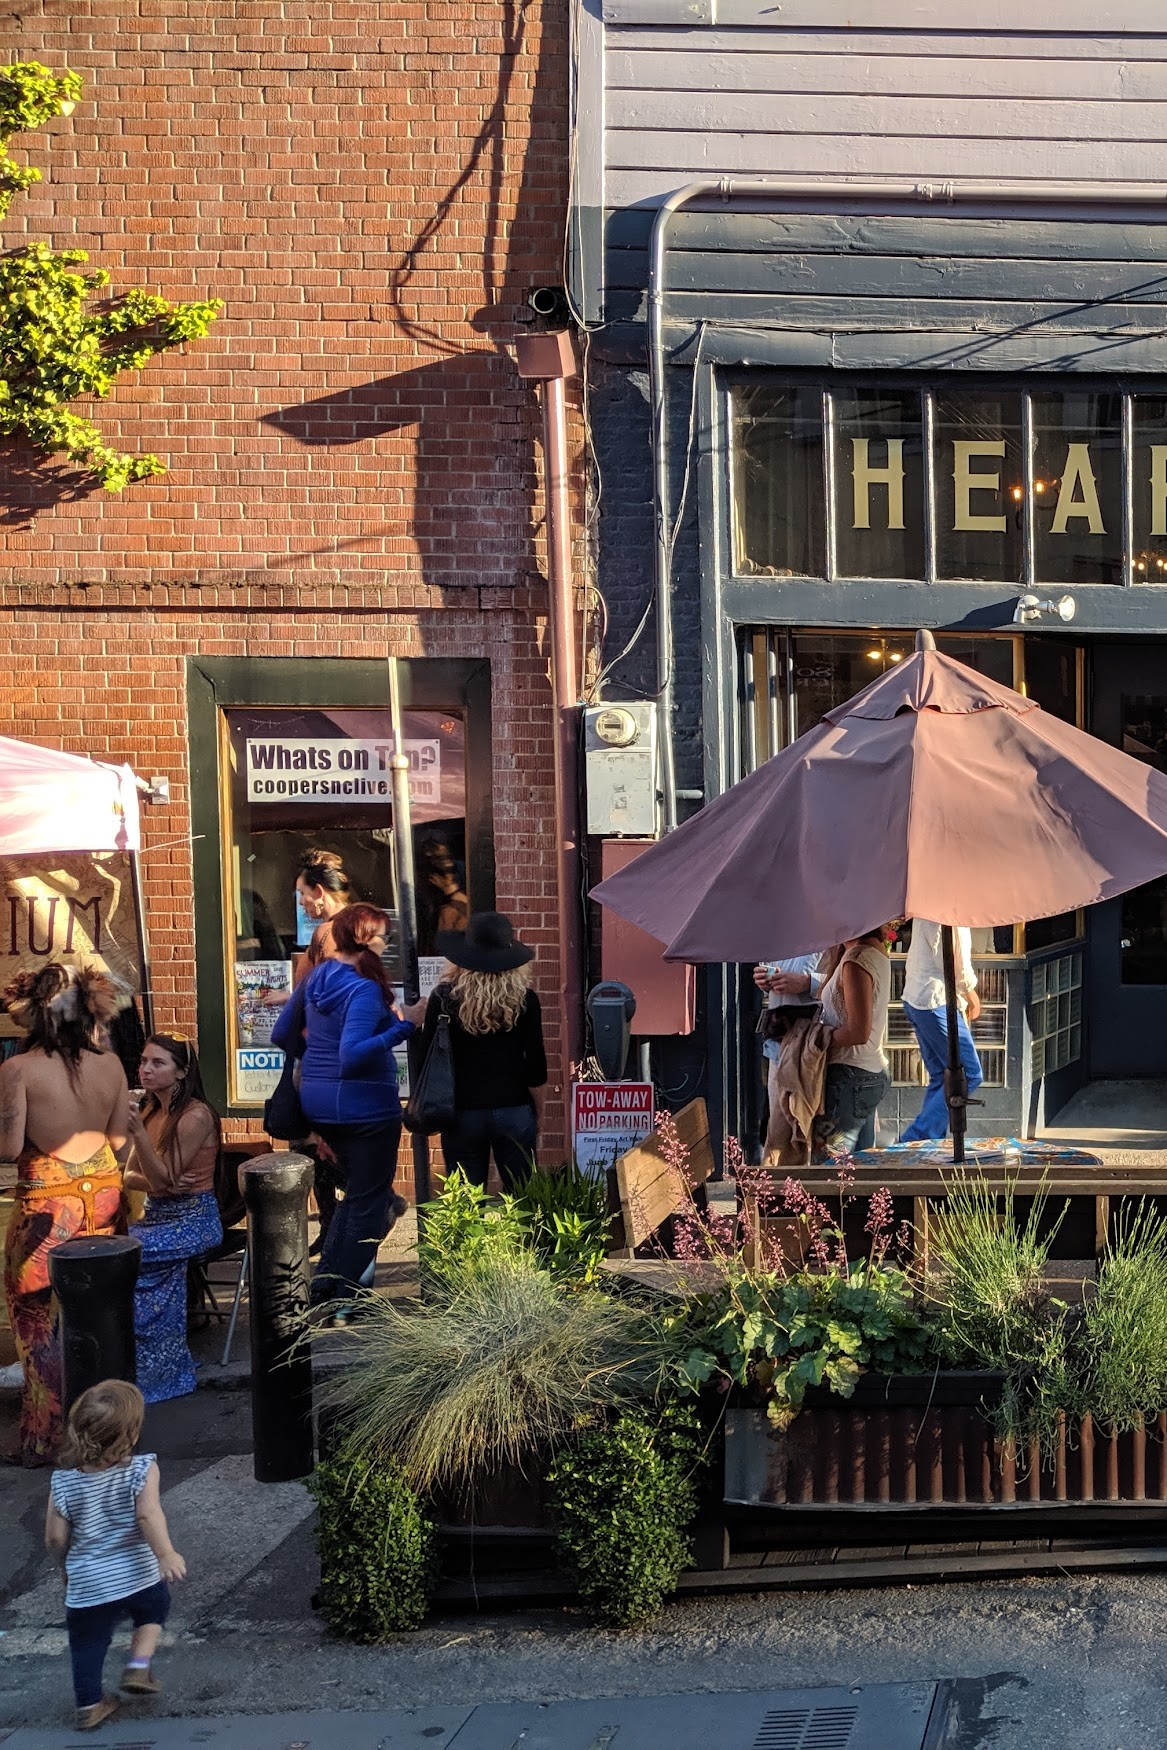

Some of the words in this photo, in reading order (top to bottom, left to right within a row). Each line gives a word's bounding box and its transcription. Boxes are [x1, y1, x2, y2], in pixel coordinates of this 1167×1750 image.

[250, 744, 331, 771] Whats
[337, 748, 369, 771] on
[375, 745, 436, 774] Tp?
[253, 778, 433, 796] coopersnclive.om
[236, 968, 270, 979] SUMMER
[241, 1053, 286, 1068] NOTI
[578, 1090, 648, 1108] TOW-AWAY
[579, 1112, 597, 1130] NO
[599, 1115, 649, 1130] PARKING
